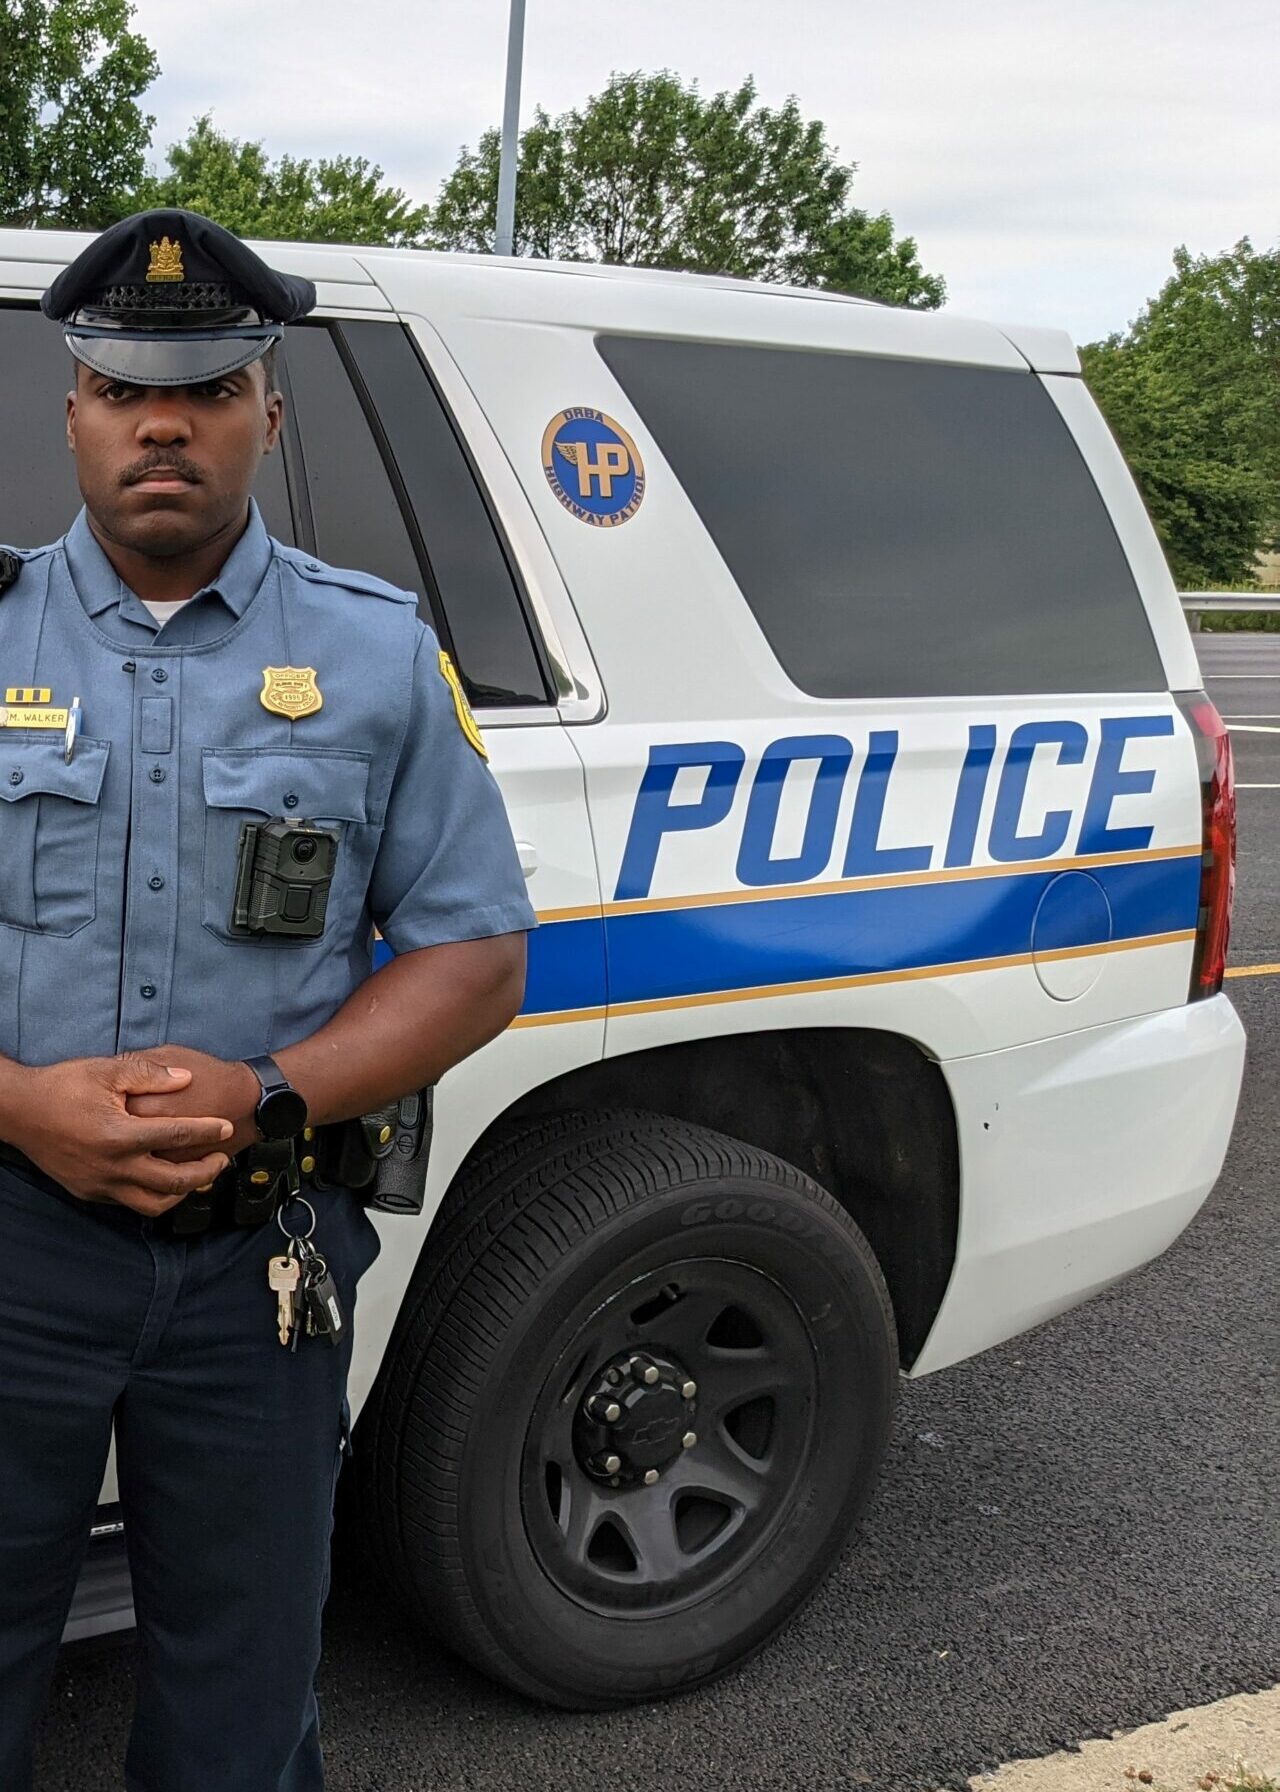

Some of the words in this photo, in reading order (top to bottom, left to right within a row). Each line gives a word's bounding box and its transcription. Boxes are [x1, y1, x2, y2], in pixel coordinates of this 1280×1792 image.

[563, 407, 604, 423] DRBA
[544, 465, 606, 526] HIGHWAY
[610, 471, 646, 525] PATROL
[575, 441, 630, 497] HP
[9, 713, 21, 722] M.
[24, 713, 65, 723] WALKER
[612, 714, 1175, 901] POLICE
